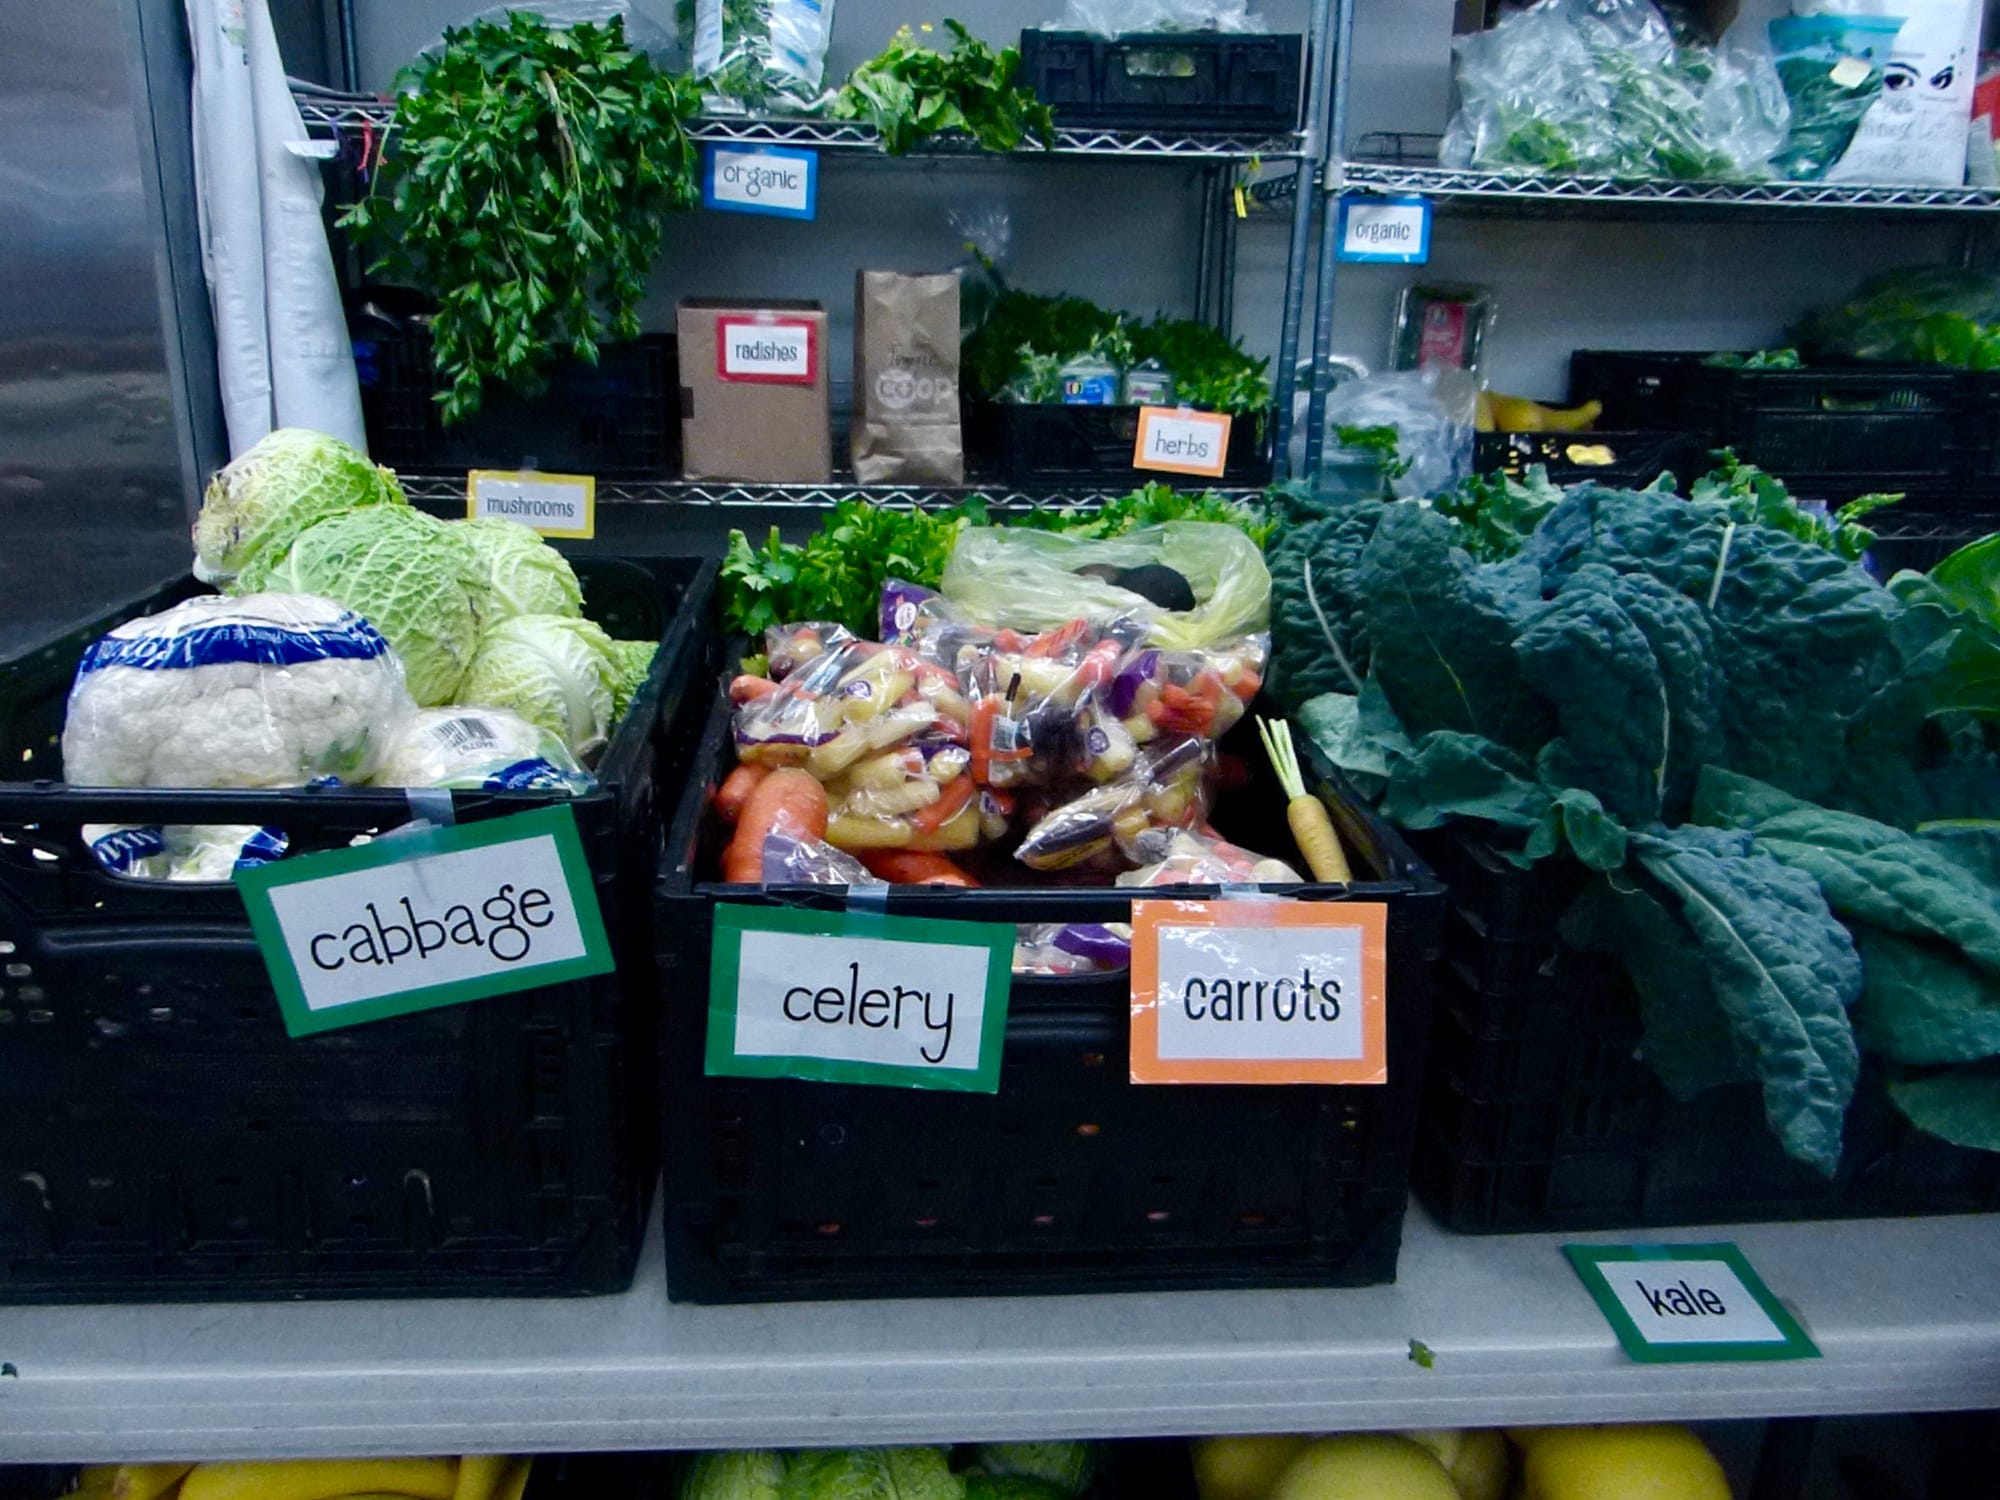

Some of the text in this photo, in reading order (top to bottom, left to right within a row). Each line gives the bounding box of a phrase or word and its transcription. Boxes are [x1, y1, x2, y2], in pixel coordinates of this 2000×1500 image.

[723, 165, 798, 197] organic
[1355, 221, 1410, 244] organic
[735, 340, 798, 362] radishes
[1155, 429, 1209, 458] herbs
[486, 496, 575, 517] mushrooms
[310, 883, 554, 970] cabbage
[1183, 968, 1342, 1022] carrots
[783, 961, 954, 1064] celery
[1634, 1280, 1726, 1316] kale
